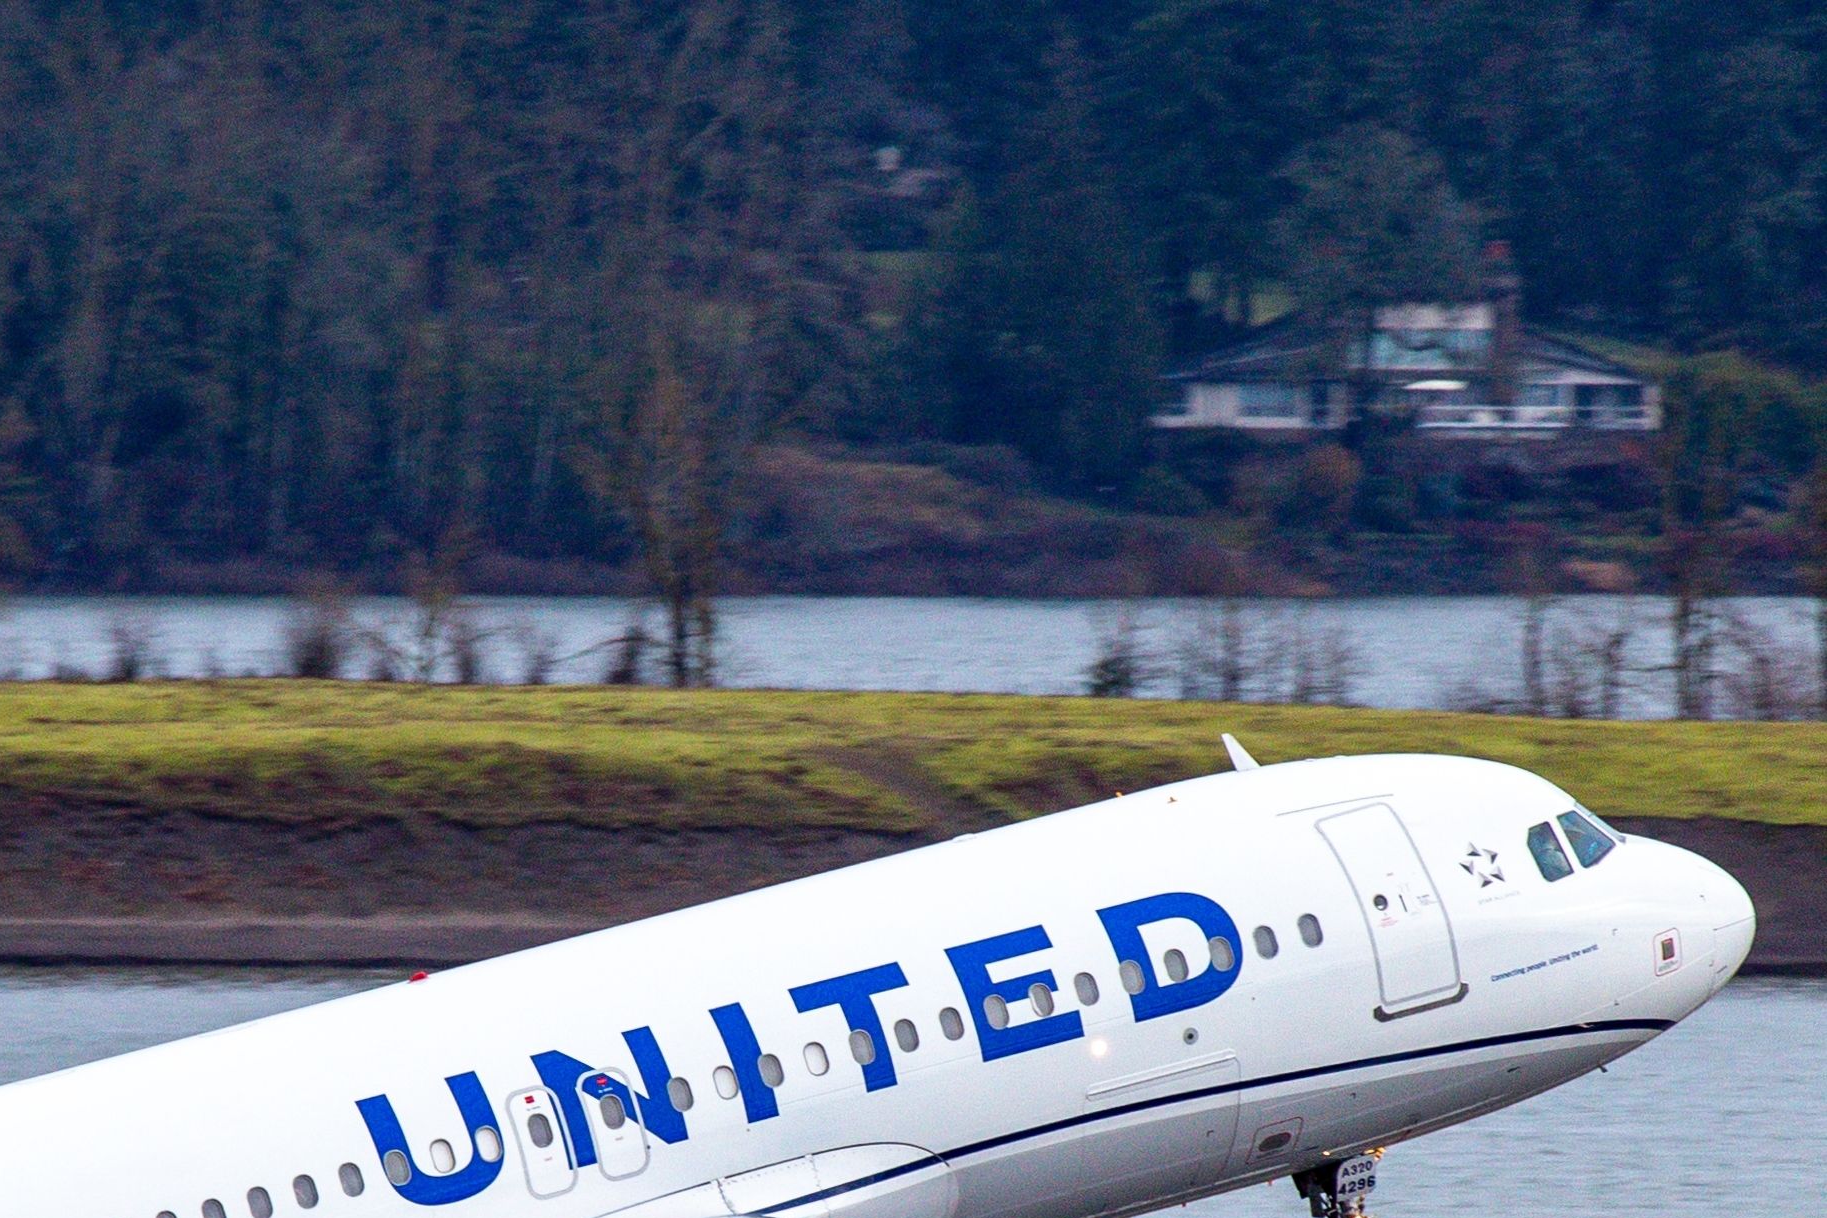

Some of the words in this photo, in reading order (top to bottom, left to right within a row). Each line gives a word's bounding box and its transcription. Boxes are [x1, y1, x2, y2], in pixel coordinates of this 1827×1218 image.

[354, 891, 1244, 1207] UNITED
[1342, 1160, 1373, 1178] A320
[1338, 1175, 1376, 1195] 4296
